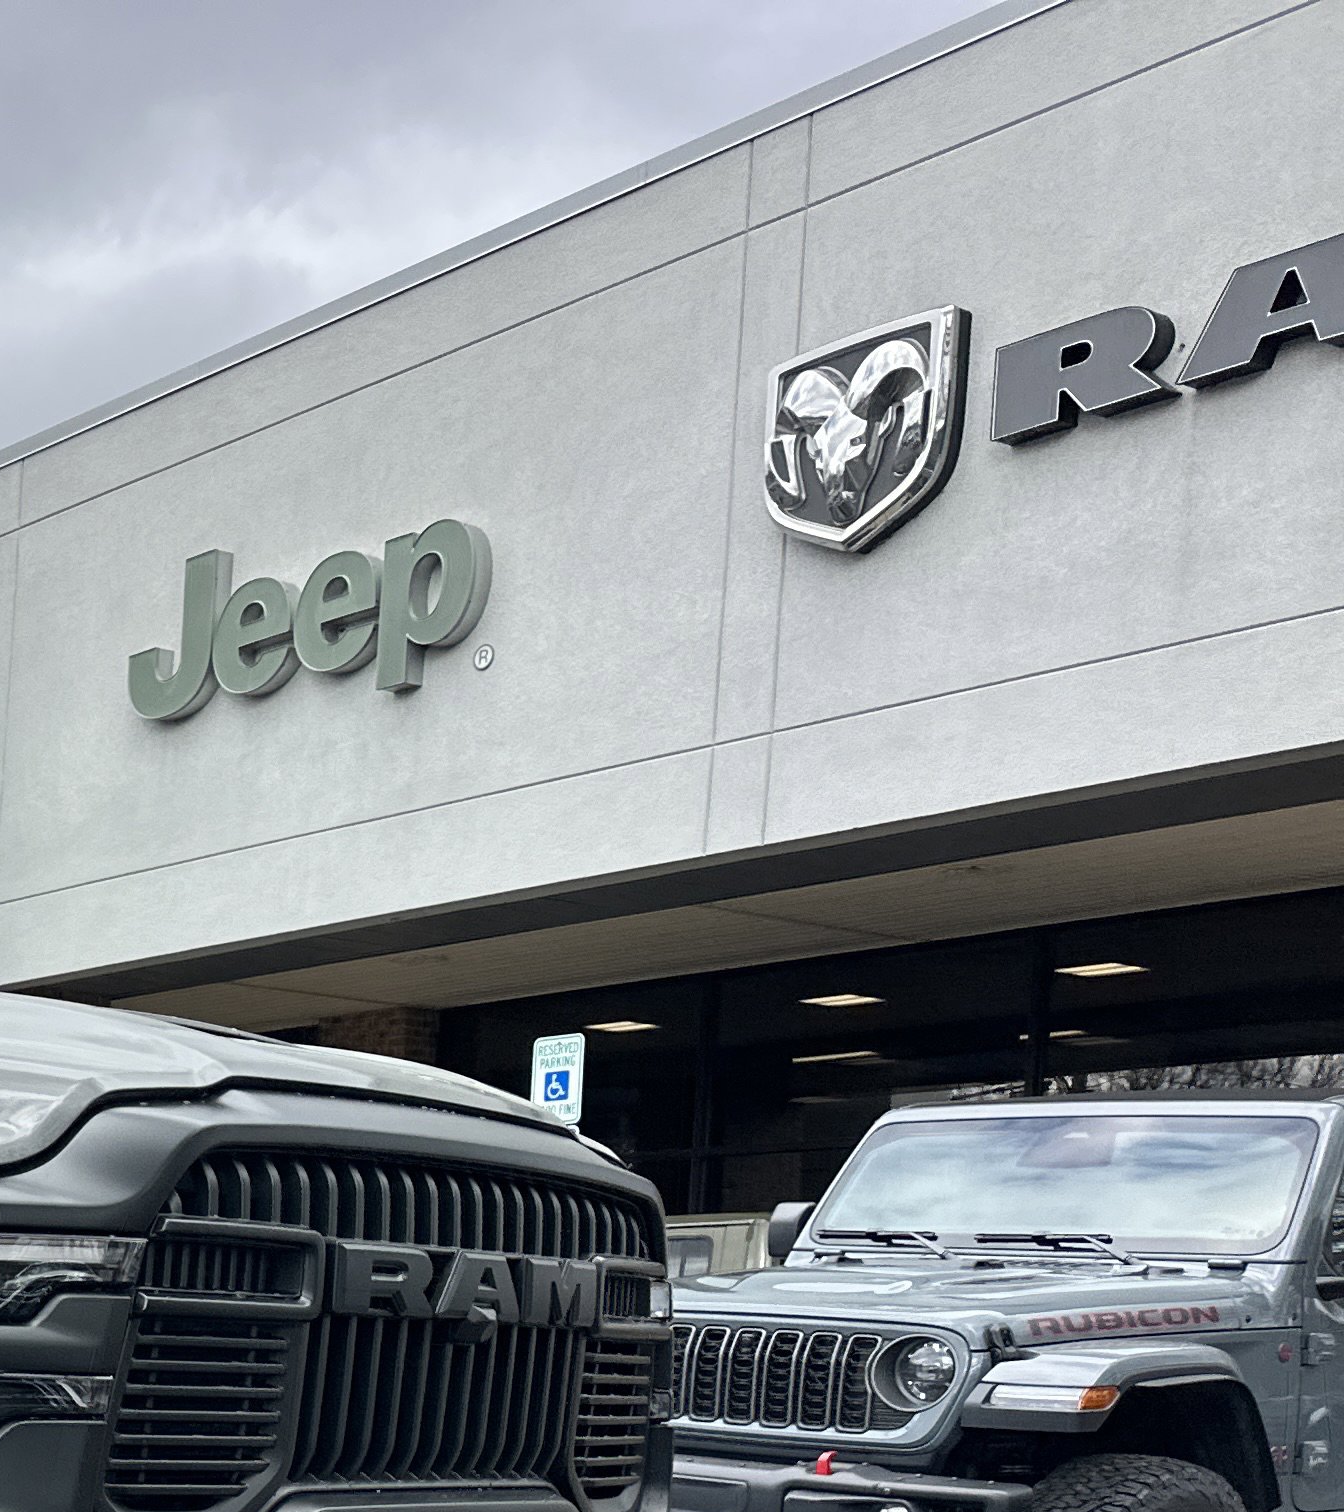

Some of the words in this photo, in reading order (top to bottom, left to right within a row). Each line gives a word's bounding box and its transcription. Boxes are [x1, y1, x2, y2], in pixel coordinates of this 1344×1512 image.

[128, 518, 493, 722] Jeep
[538, 1041, 579, 1056] RESERVED
[540, 1055, 576, 1069] PARKING
[333, 1240, 598, 1328] RAM
[1027, 1306, 1221, 1336] RUBICON
